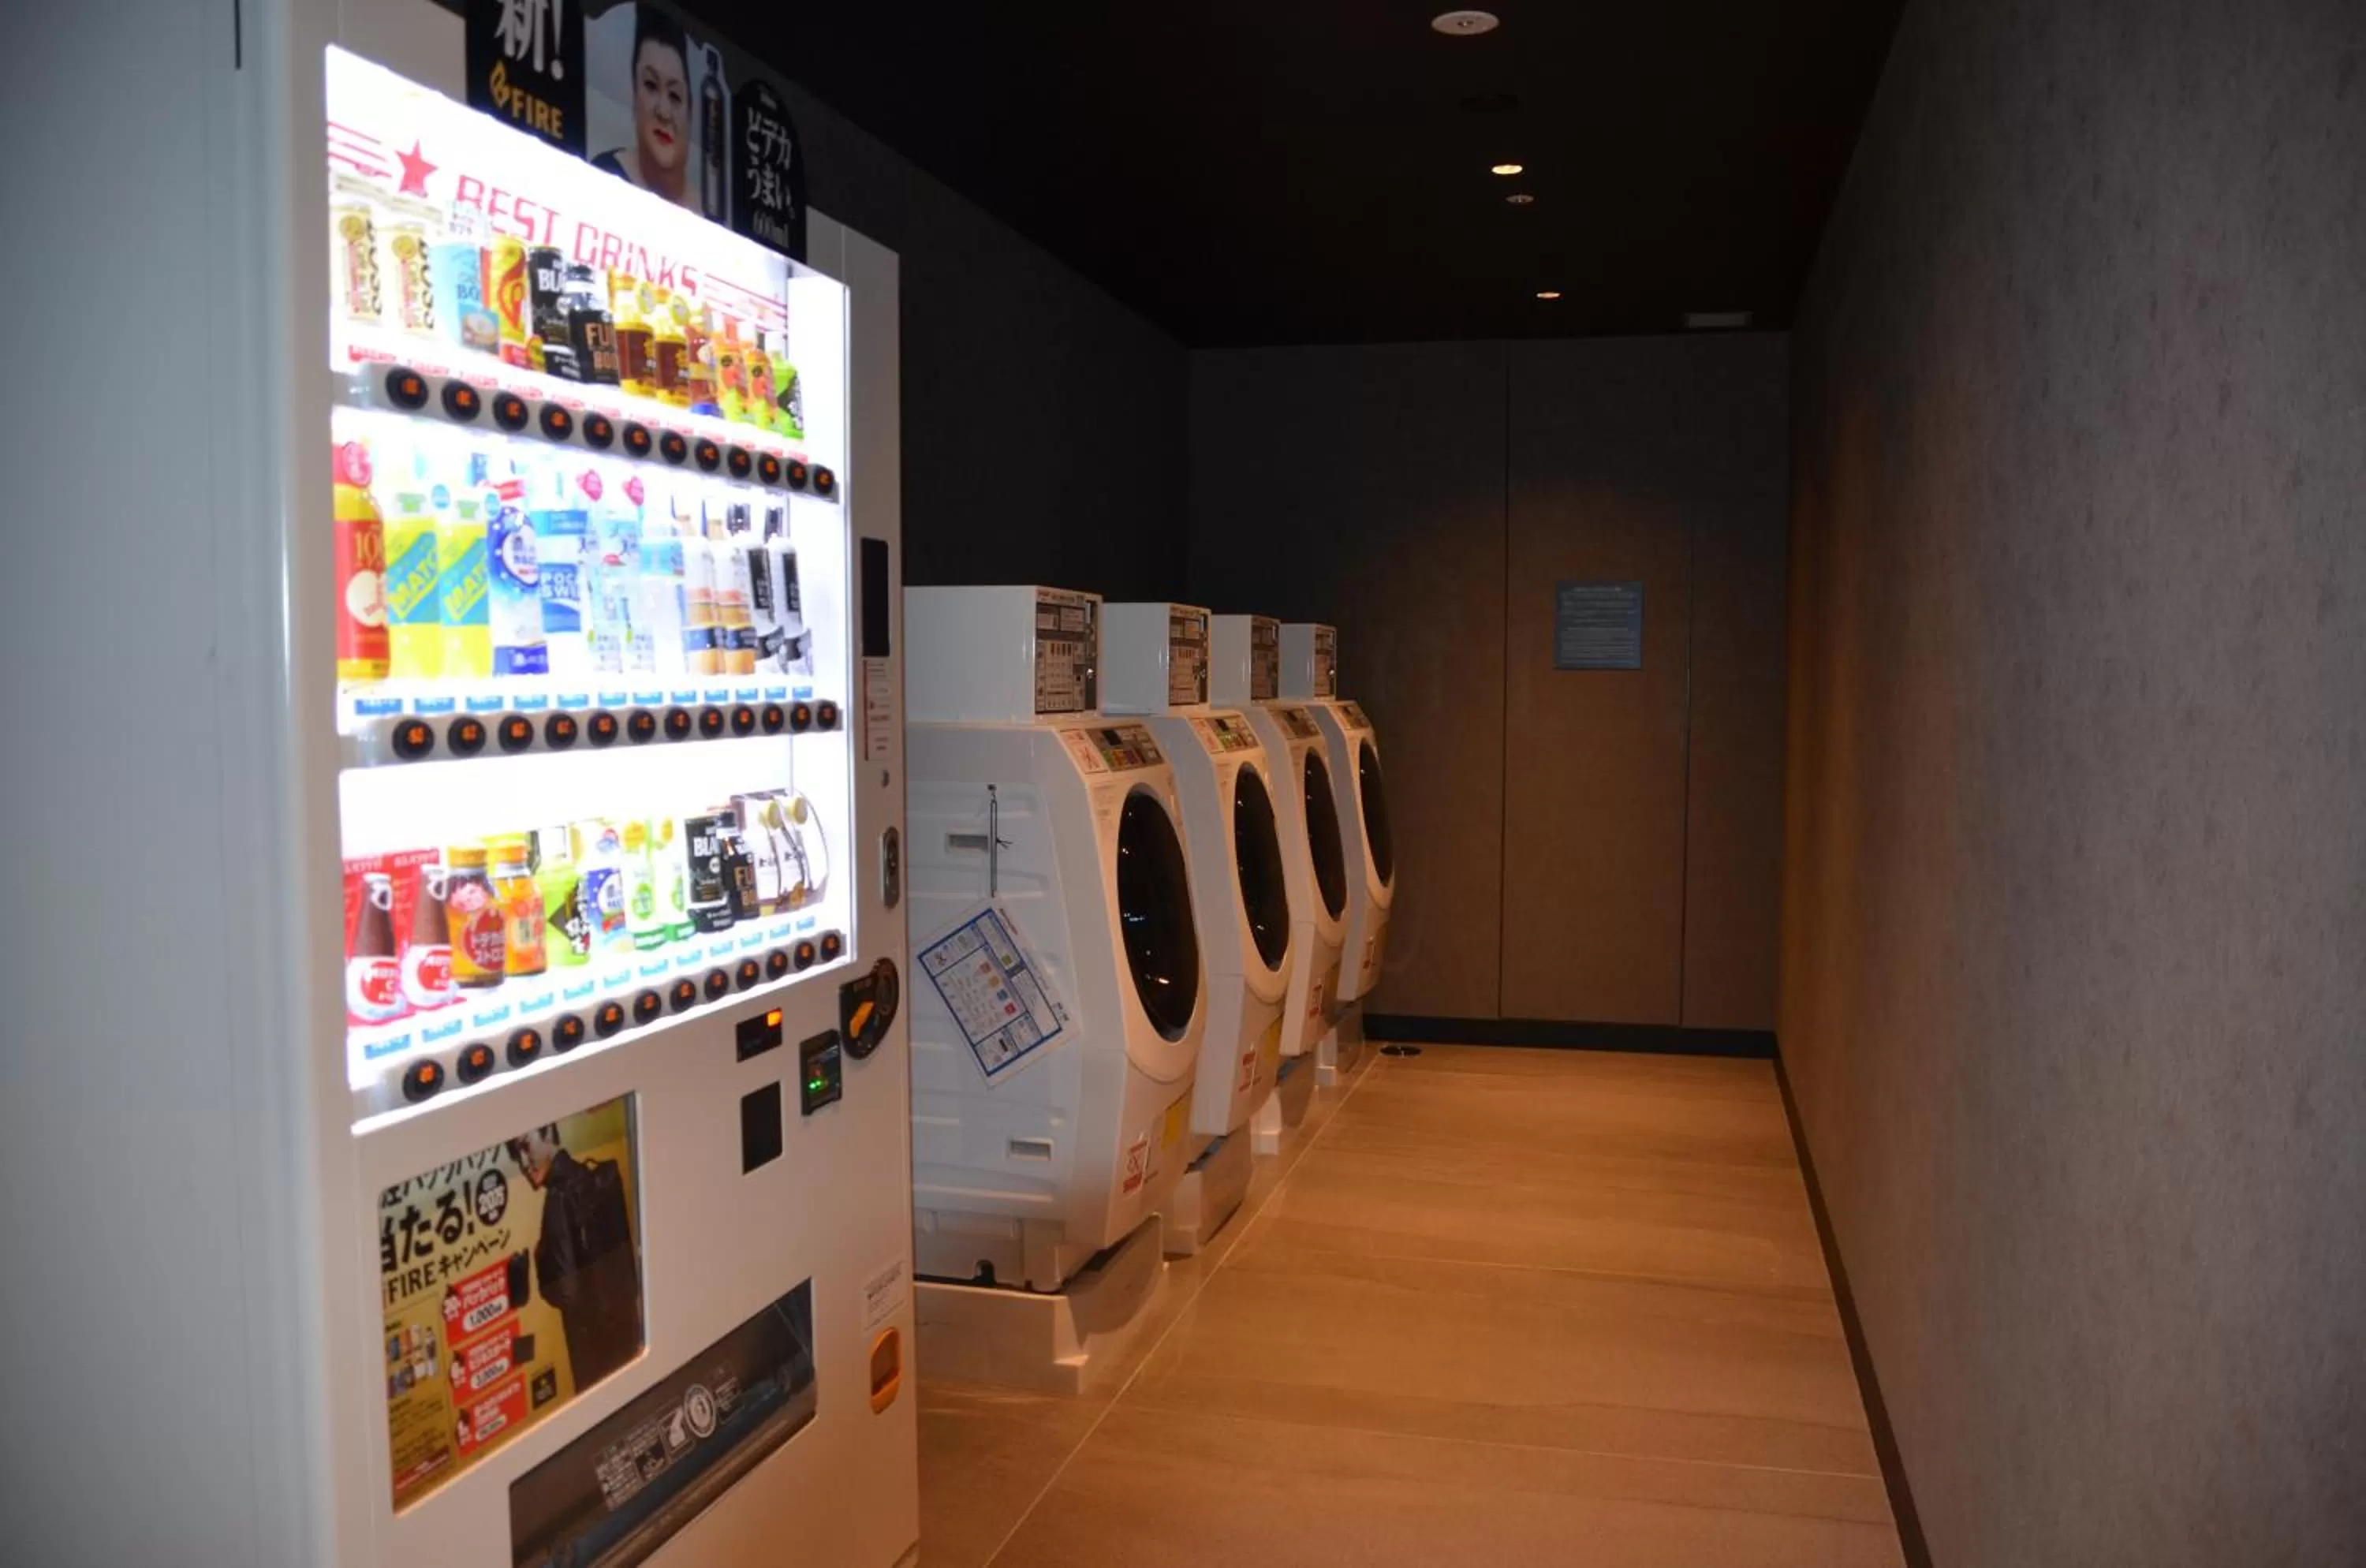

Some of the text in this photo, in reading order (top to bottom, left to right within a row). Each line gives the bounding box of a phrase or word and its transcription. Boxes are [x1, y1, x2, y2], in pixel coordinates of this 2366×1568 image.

[511, 87, 564, 140] FIRE
[455, 174, 560, 248] BEST
[571, 221, 700, 297] DRINKS
